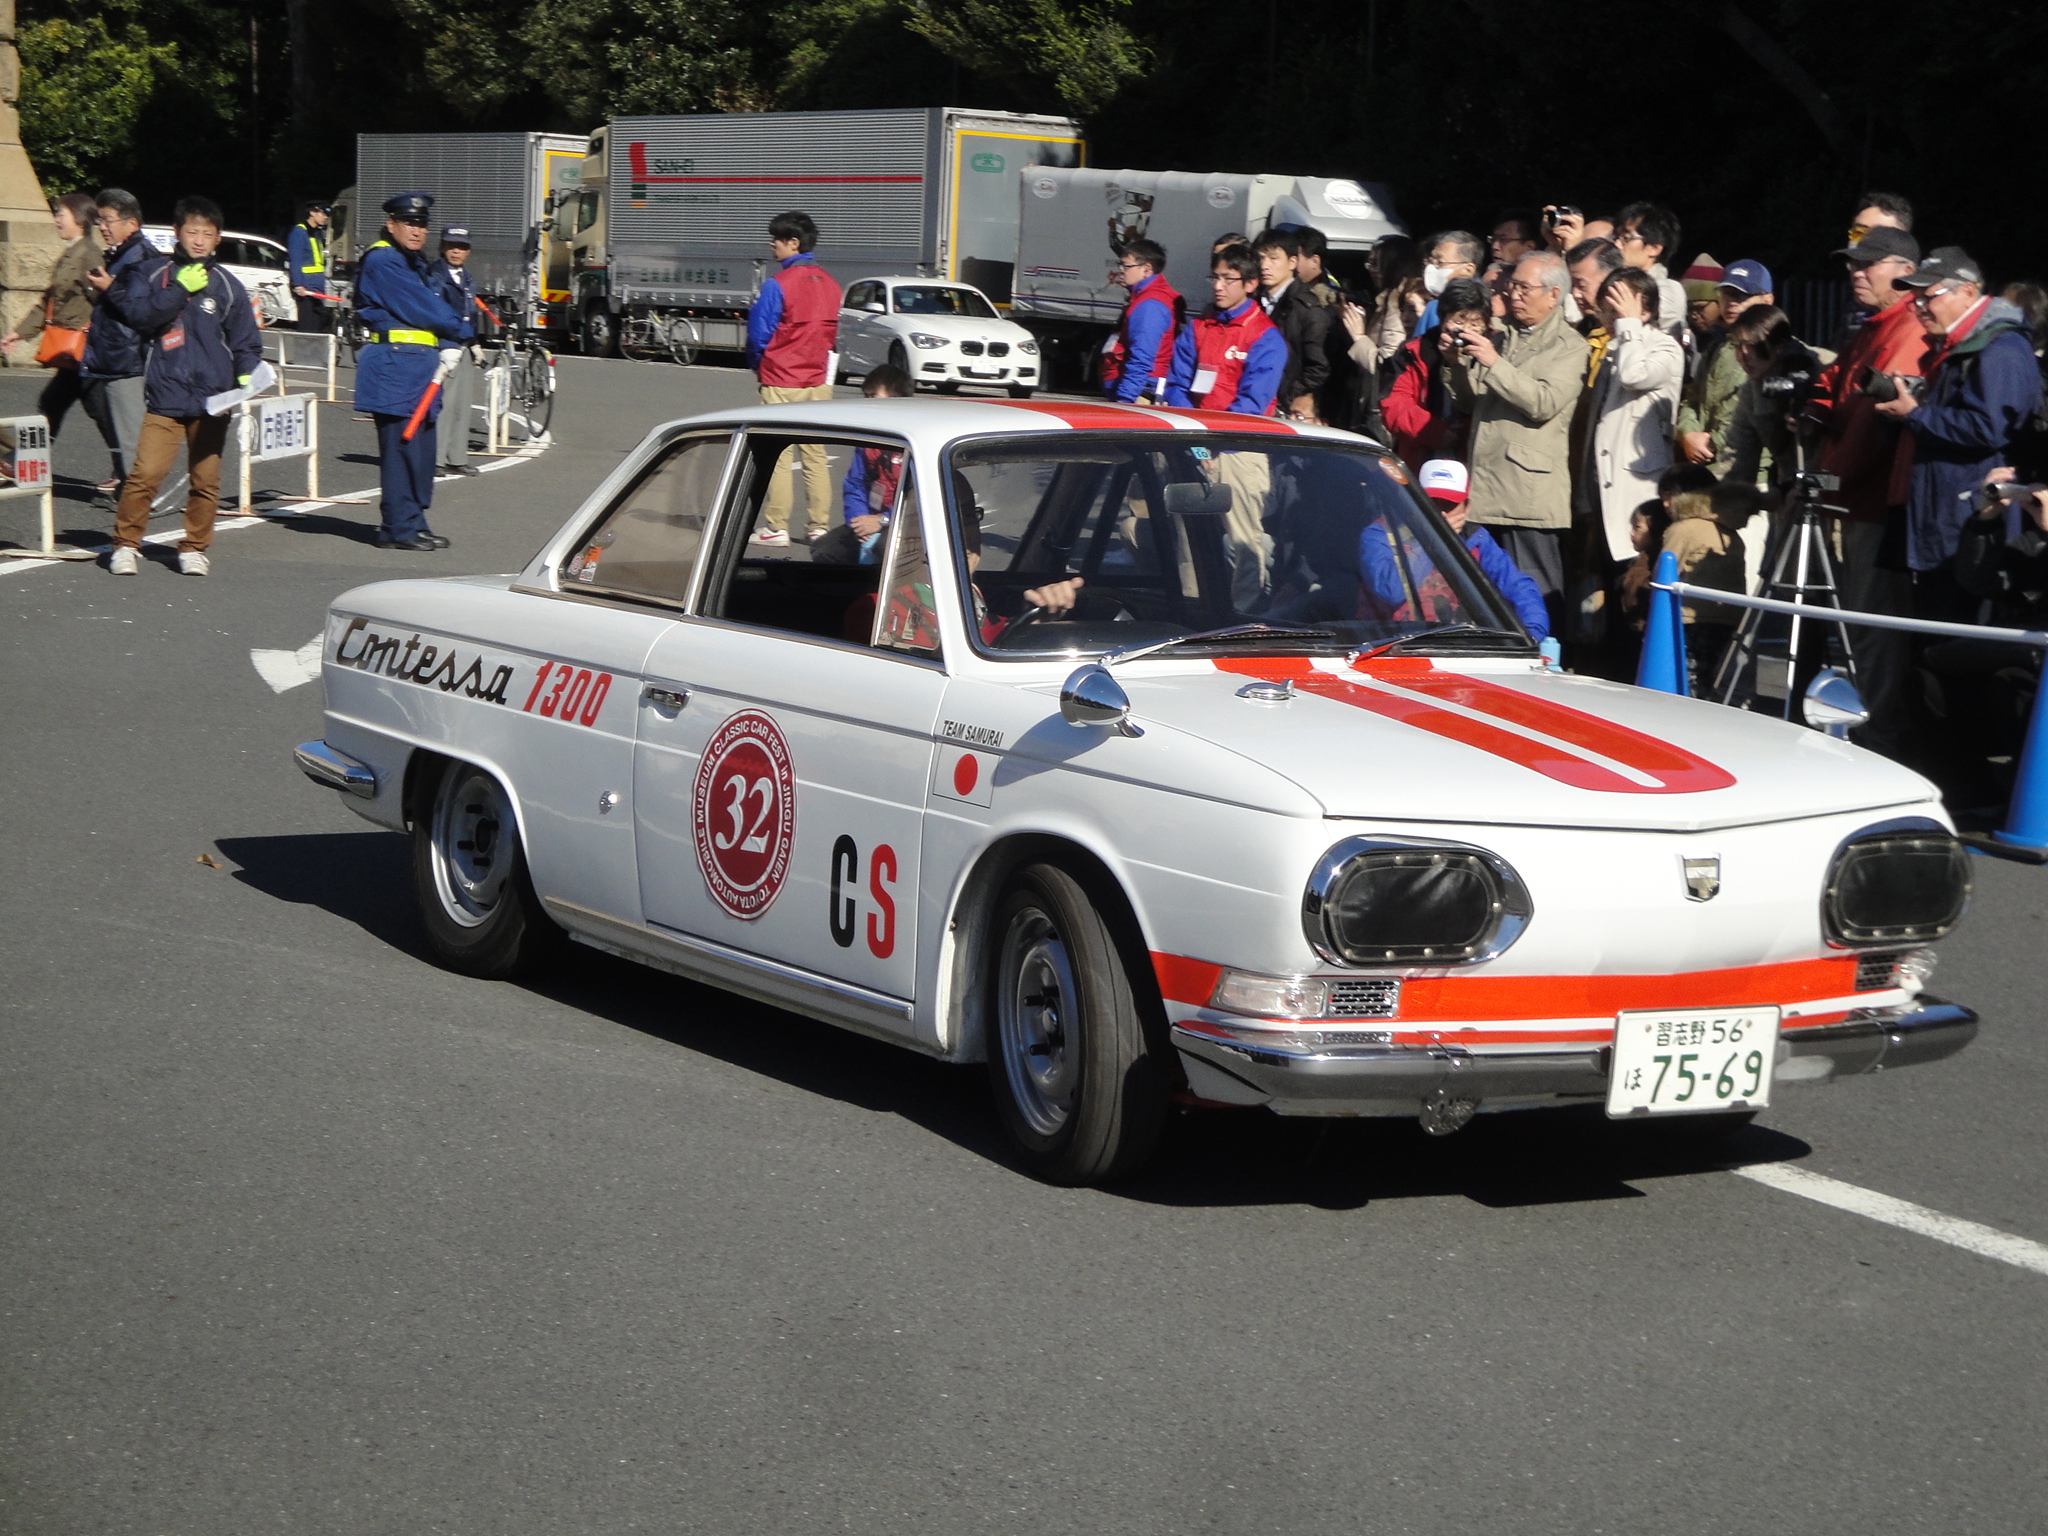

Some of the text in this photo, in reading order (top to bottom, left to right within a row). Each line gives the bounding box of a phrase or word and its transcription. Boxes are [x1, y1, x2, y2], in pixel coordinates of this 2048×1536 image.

[1330, 196, 1372, 206] NISSAN
[336, 617, 613, 727] Contessa 1300
[942, 720, 1004, 747] TEAM SAMURAI
[697, 720, 792, 909] TOYOTA AUTOMOBILE MUSEUM CLASSIC CAR FEST in JINGU GAIEN
[715, 774, 774, 854] 32
[1657, 1019, 1743, 1046] 習志野 56
[1624, 1050, 1762, 1103] ほ 75-69
